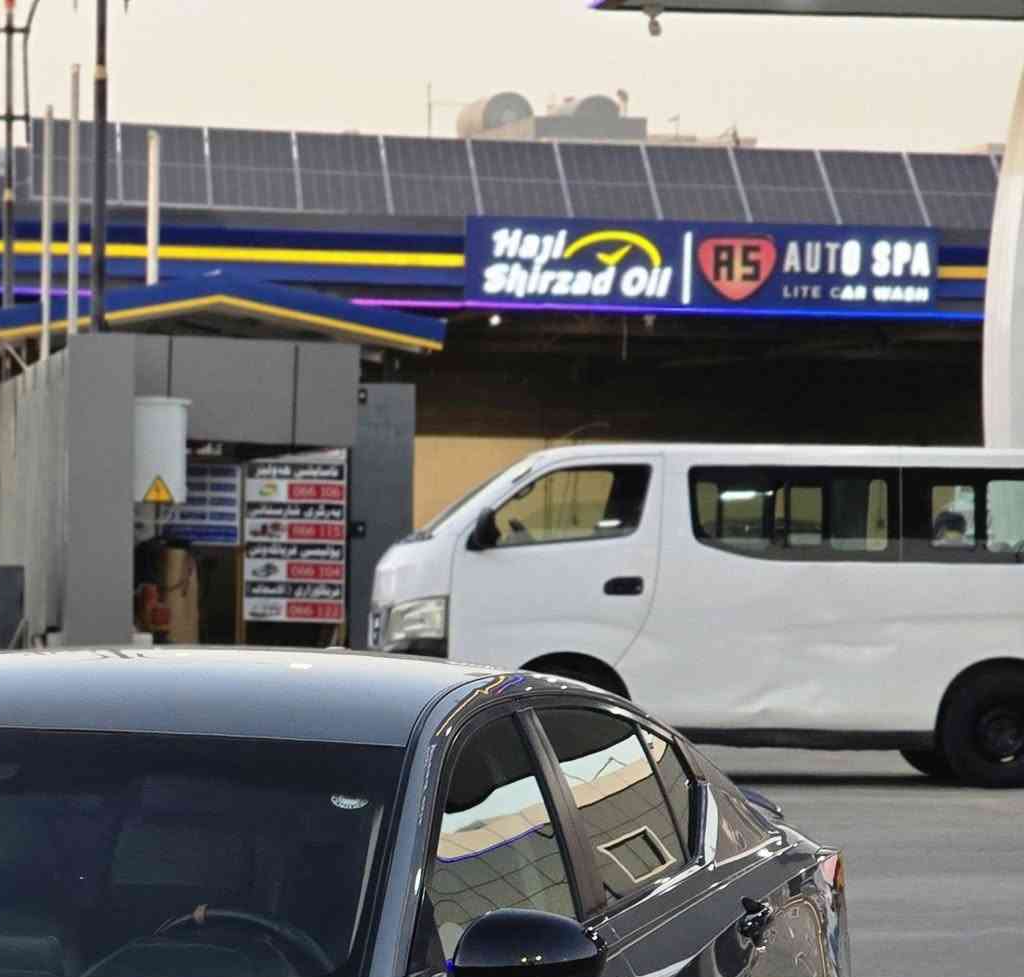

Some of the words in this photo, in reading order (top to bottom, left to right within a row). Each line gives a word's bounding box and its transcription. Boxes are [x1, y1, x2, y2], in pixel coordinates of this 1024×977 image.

[783, 240, 861, 276] AUTO
[872, 240, 930, 277] SPA
[483, 262, 616, 298] Shirzad
[621, 266, 672, 297] Oil
[783, 286, 821, 299] LITE
[830, 286, 866, 300] CAR
[873, 287, 929, 302] WASH
